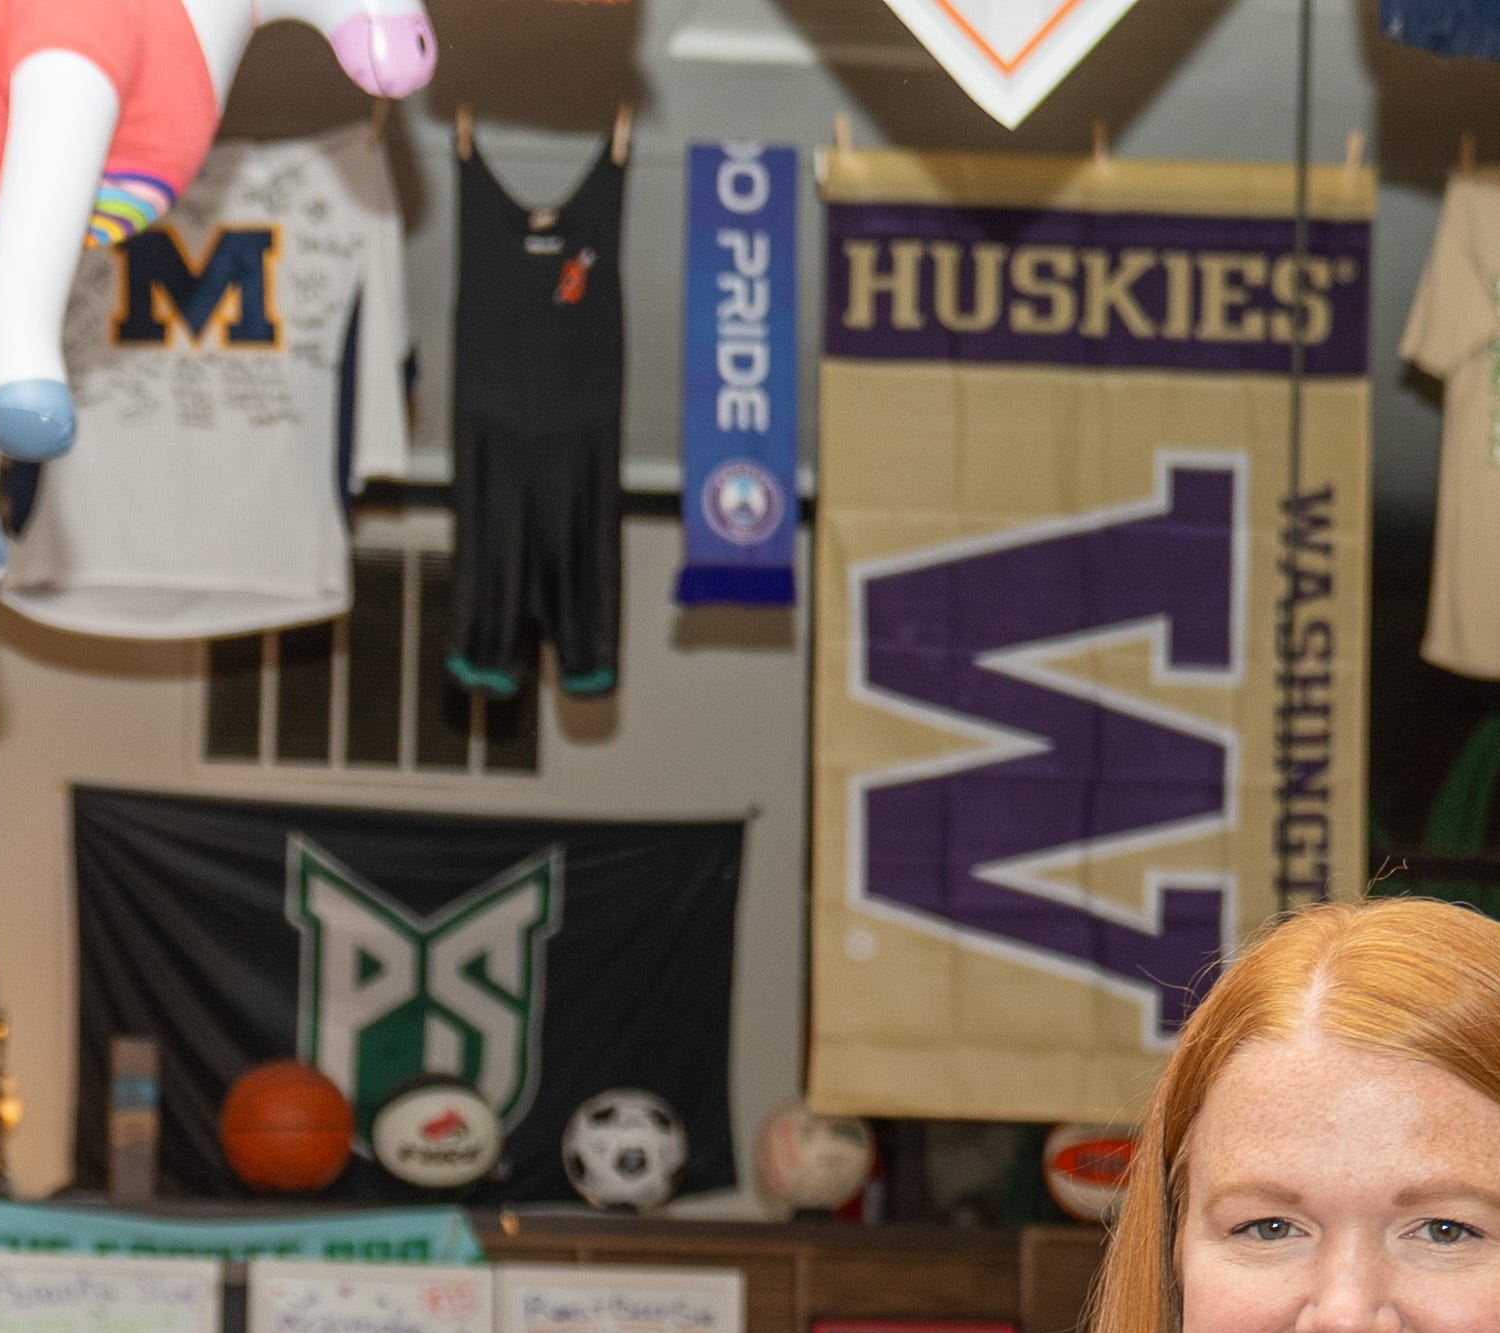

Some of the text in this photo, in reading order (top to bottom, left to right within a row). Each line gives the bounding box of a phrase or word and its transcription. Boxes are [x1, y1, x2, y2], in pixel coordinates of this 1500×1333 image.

[110, 222, 284, 352] M
[716, 228, 771, 434] PRIDE
[842, 238, 1336, 346] HUSKIES
[847, 448, 1249, 1052] W
